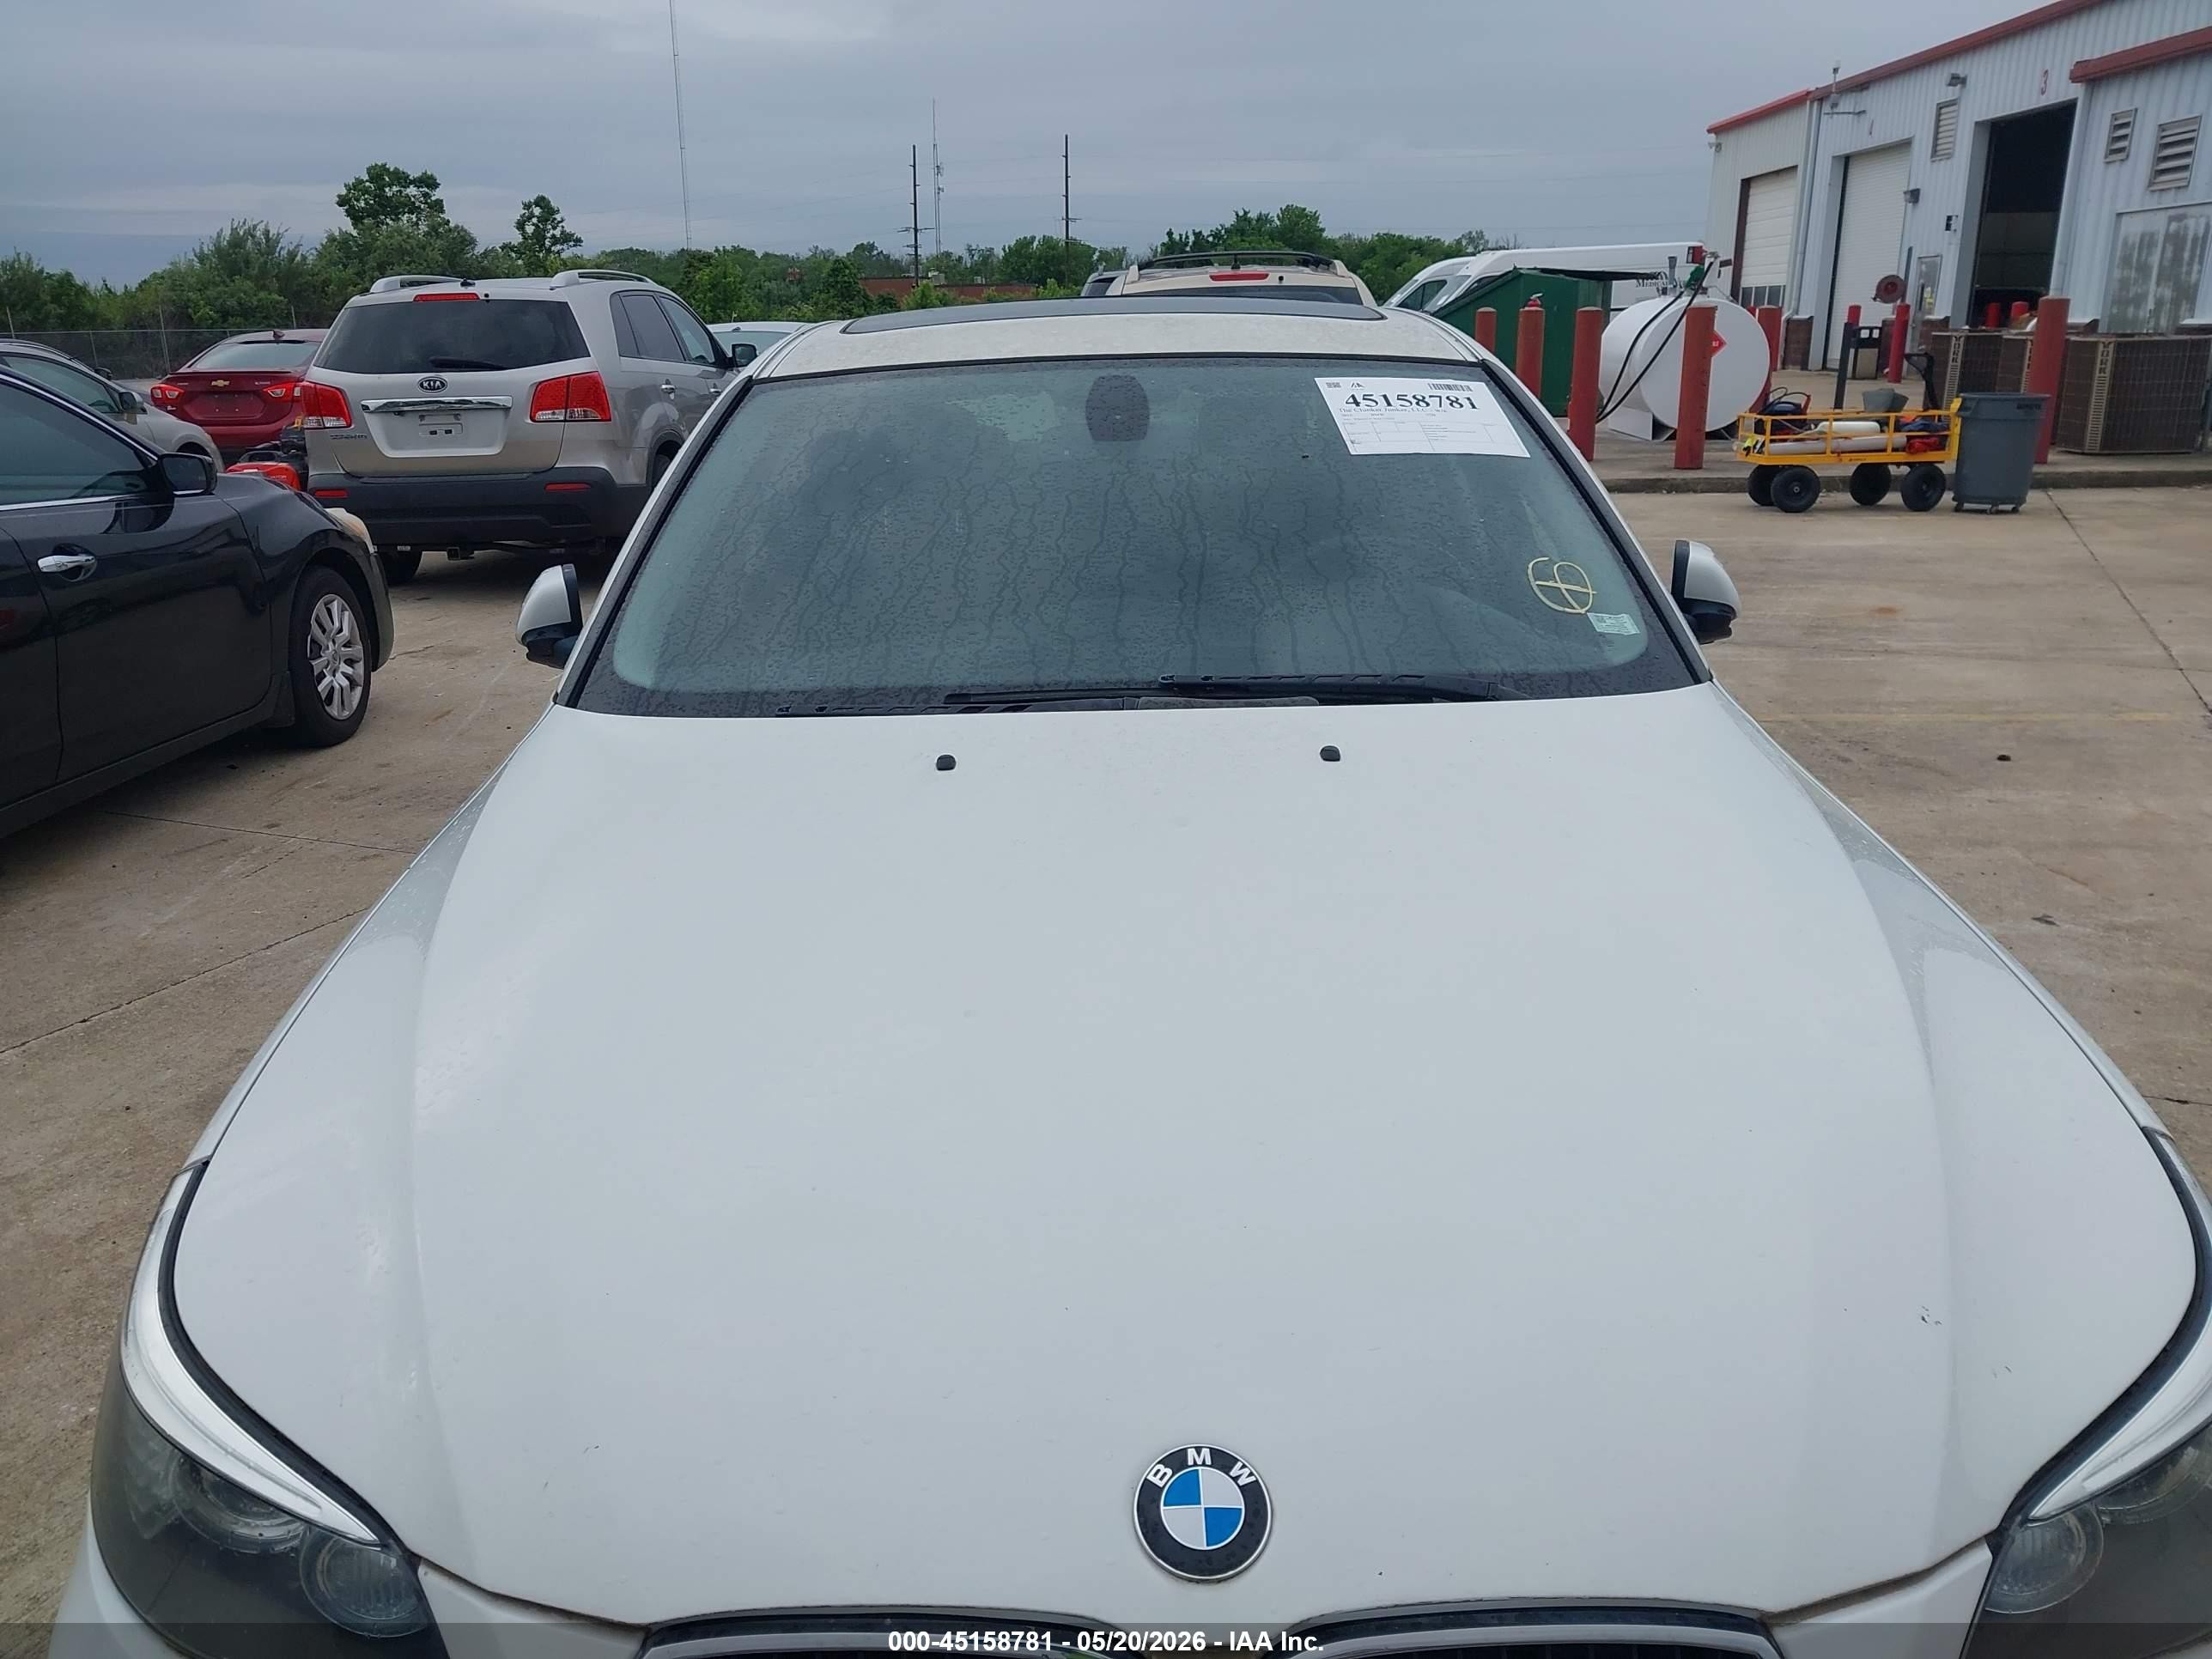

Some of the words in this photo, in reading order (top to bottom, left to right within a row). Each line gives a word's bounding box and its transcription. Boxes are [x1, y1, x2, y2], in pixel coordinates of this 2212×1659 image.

[2041, 70, 2049, 95] 3
[1345, 393, 1480, 410] 45158781
[1146, 1448, 1256, 1487] BMW
